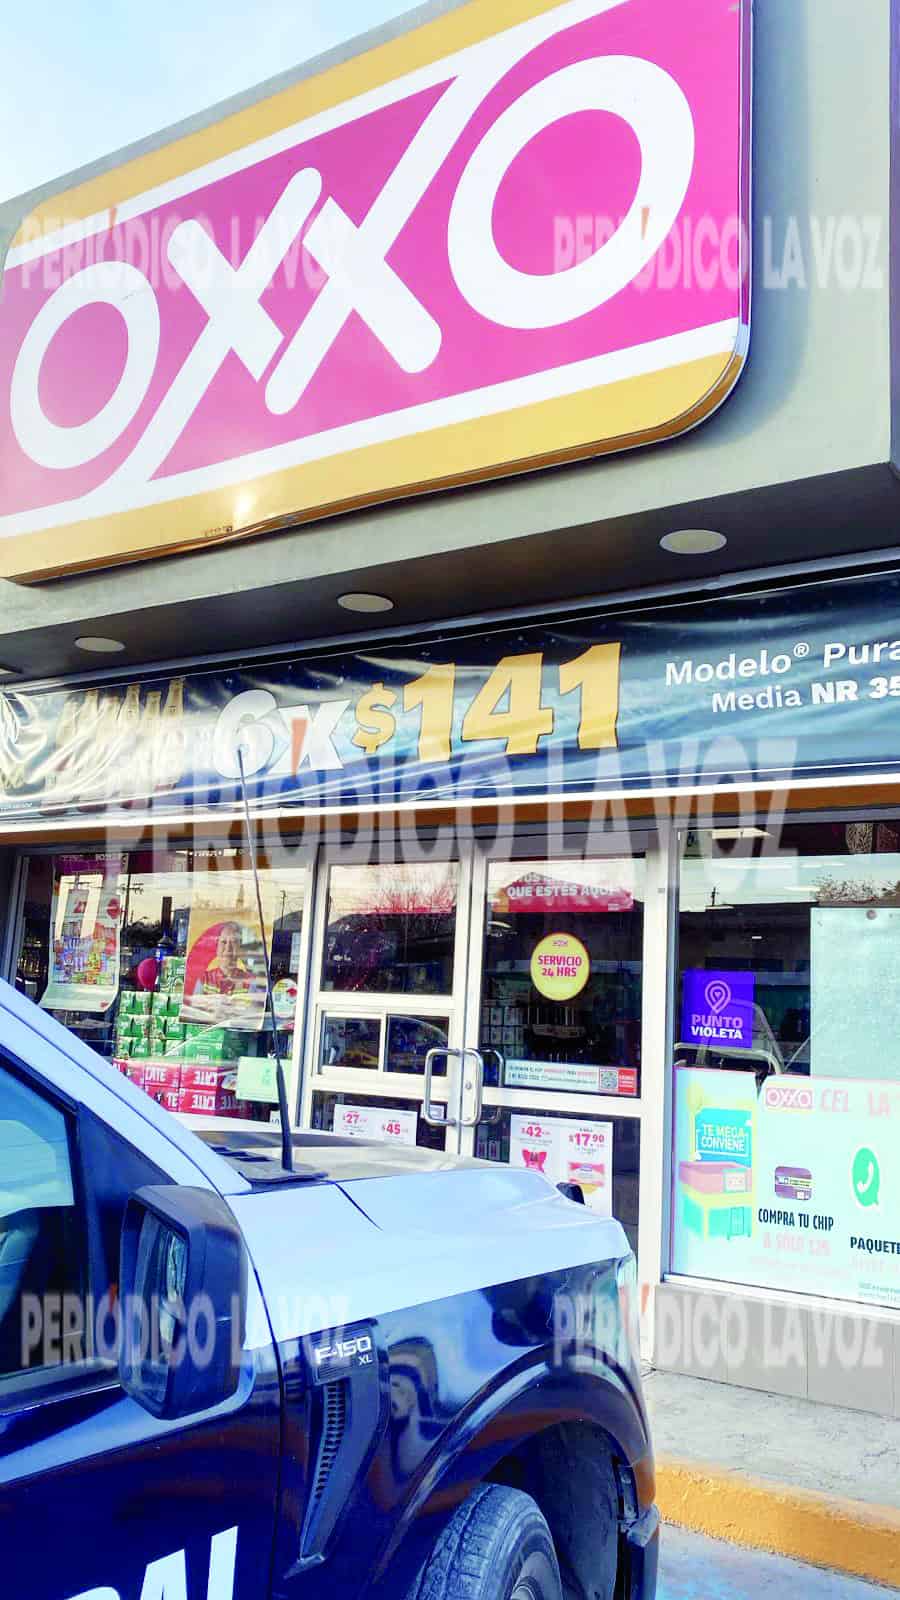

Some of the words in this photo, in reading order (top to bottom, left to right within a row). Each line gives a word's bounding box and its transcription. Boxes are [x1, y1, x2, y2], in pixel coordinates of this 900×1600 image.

[10, 55, 695, 484] OXXO
[351, 642, 622, 763] $141
[712, 684, 803, 713] Media
[811, 680, 859, 705] NR
[506, 886, 533, 897] QUE
[537, 954, 583, 967] SERVICIO
[556, 967, 578, 978] HRS
[691, 1013, 744, 1029] PUNTO
[691, 1025, 744, 1040] VIOLETA
[766, 1089, 813, 1108] OXXO
[701, 1135, 745, 1152] CONVIENE
[758, 1208, 796, 1227] COMPRA
[798, 1213, 810, 1229] TU
[812, 1215, 834, 1232] CHIP
[315, 1335, 372, 1366] F-150
[358, 1354, 373, 1366] XL
